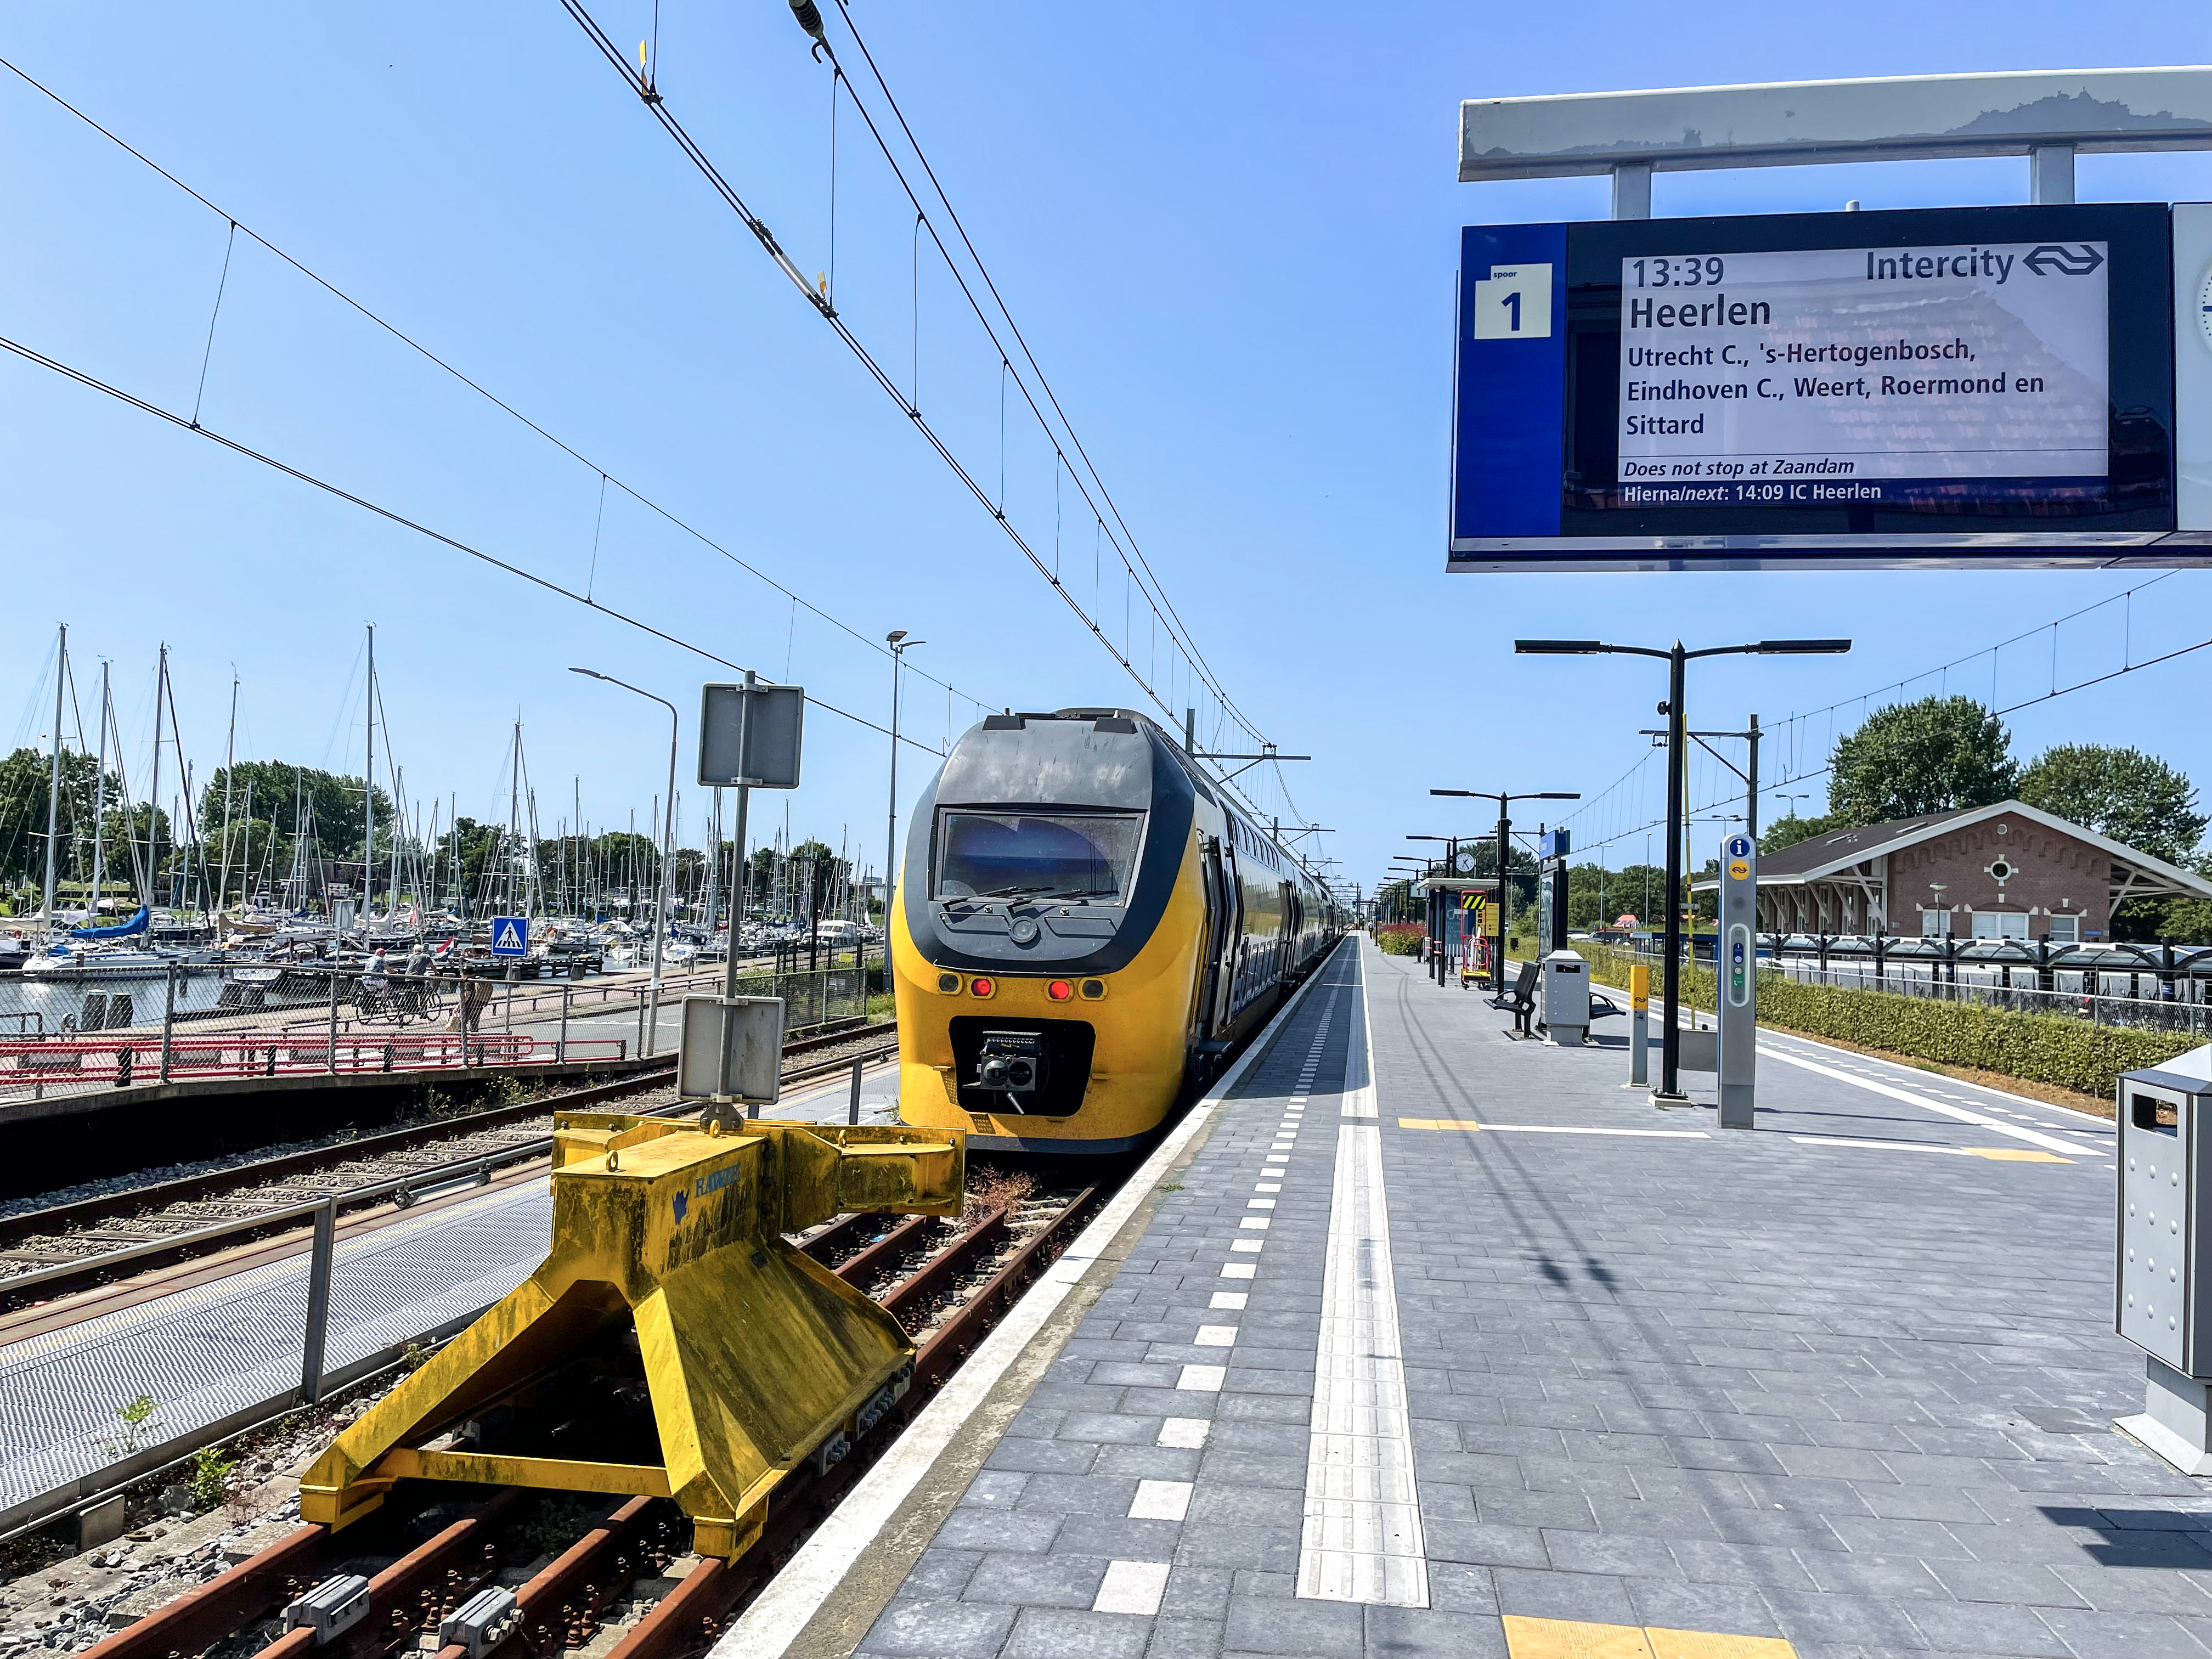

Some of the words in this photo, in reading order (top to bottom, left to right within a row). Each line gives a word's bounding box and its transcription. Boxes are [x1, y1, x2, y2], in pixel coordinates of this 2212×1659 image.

[1493, 270, 1517, 279] spoor
[1633, 257, 1724, 288] 13:39
[1867, 247, 2015, 285] Intercity
[1501, 292, 1521, 331] 1
[1631, 294, 1770, 329] Heerlen
[1629, 345, 1713, 367] Utrecht
[1722, 345, 1749, 368] C.,
[1760, 338, 1976, 366] 's-Hertogenbosch,
[1628, 380, 1747, 401] Eindhoven
[1757, 379, 1784, 401] C.,
[1794, 377, 1871, 399] Weert,
[1882, 371, 2006, 396] Roermond
[2015, 377, 2044, 393] en
[1627, 413, 1704, 435] Sittard
[1624, 462, 1666, 476] Does
[1672, 461, 1701, 476] not
[1706, 461, 1745, 478] stop
[1750, 460, 1769, 475] at
[1773, 458, 1854, 474] Zaandam
[1624, 486, 1729, 501] Hierna/next:
[1736, 484, 1784, 500] 14:09
[1790, 484, 1807, 500] IC
[1813, 483, 1881, 499] Heerlen
